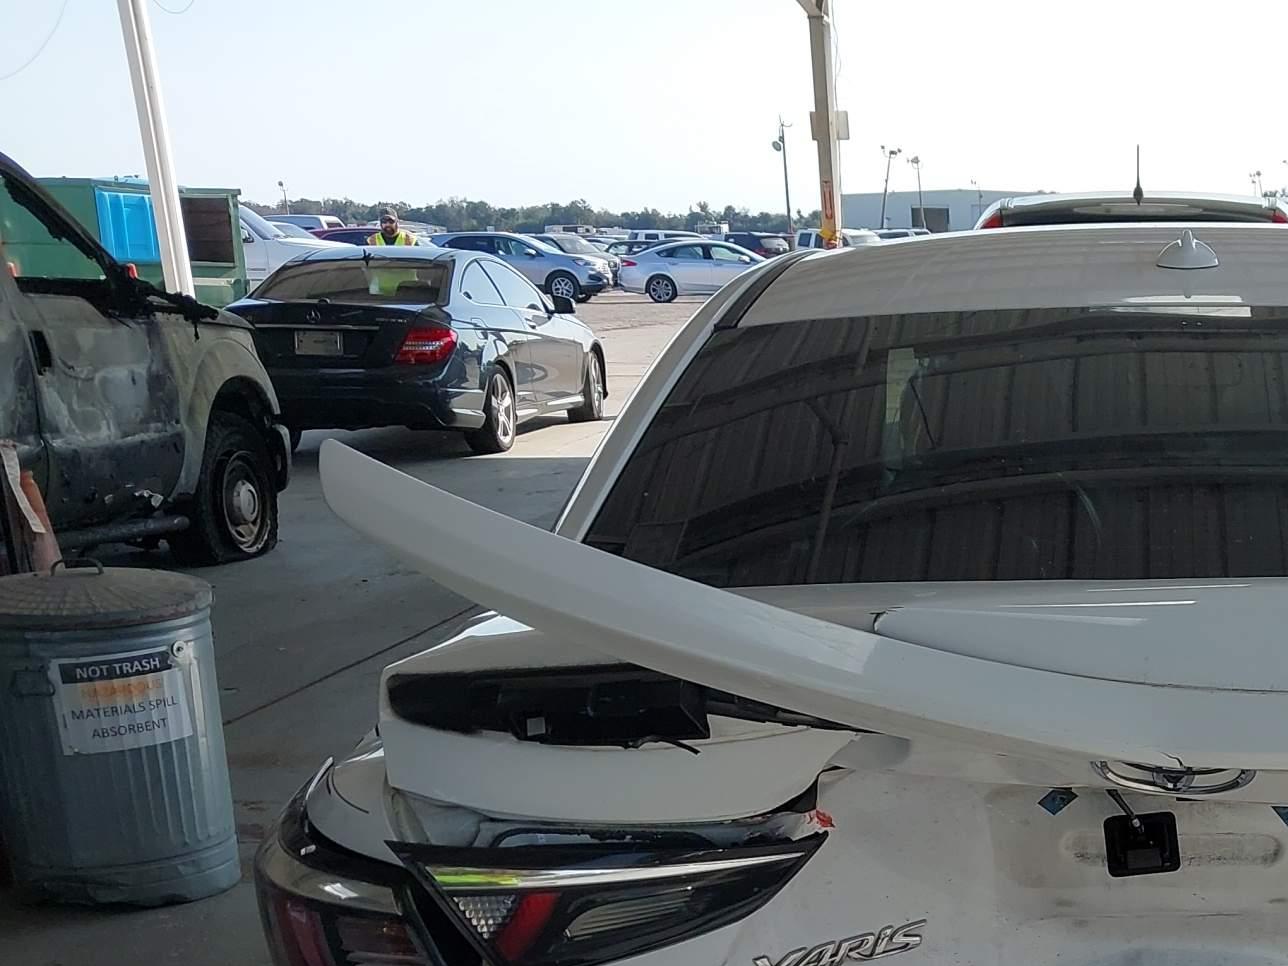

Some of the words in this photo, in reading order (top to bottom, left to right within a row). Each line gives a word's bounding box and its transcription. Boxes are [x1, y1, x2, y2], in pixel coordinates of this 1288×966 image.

[76, 664, 109, 680] NOT
[112, 657, 160, 676] TRASH
[71, 702, 146, 721] MATERIALS
[148, 695, 178, 711] SPILL
[91, 717, 169, 739] ABSORBENT
